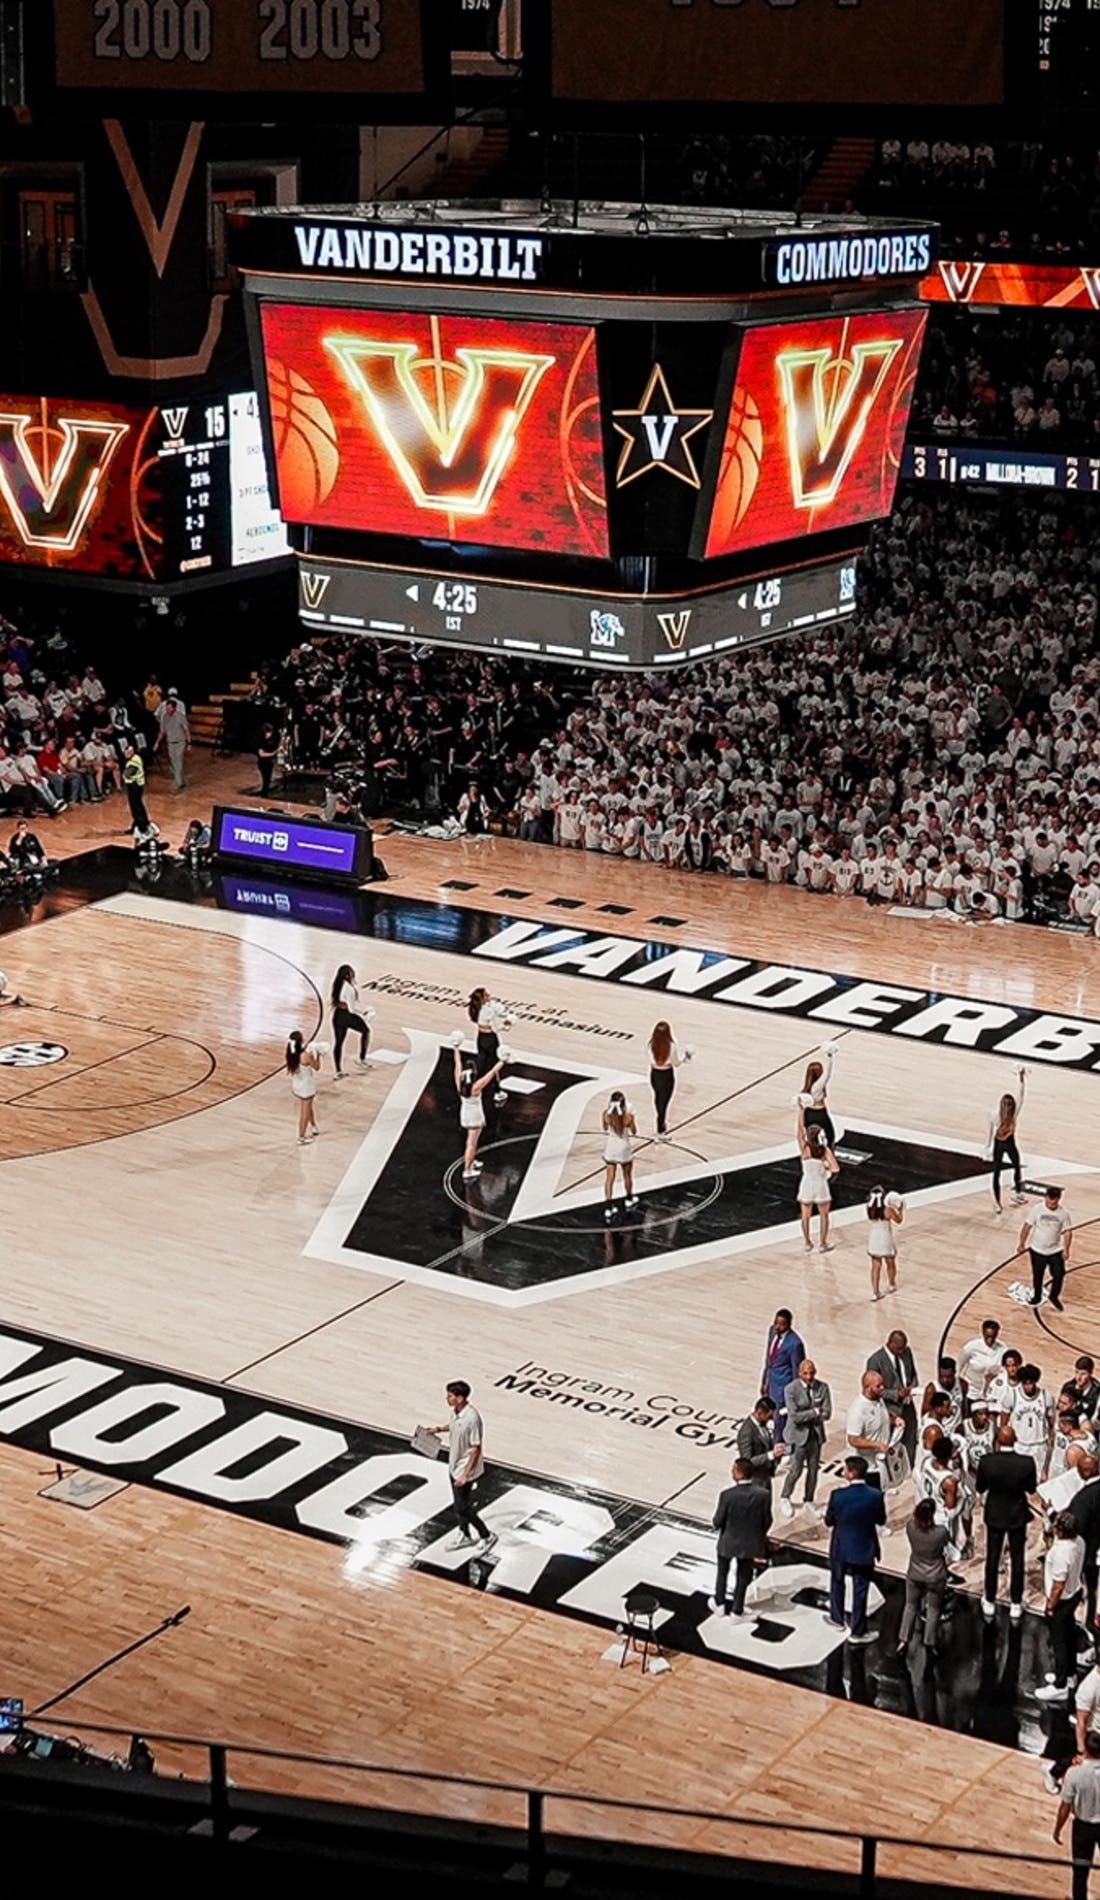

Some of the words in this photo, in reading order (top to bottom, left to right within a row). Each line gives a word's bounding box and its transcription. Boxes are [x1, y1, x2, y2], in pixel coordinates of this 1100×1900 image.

[93, 0, 212, 60] 2000
[258, 0, 383, 60] 2003
[294, 226, 543, 280] VANDERBILT
[776, 234, 931, 284] COMMODORES
[161, 407, 189, 438] V
[205, 405, 226, 438] 15
[322, 336, 556, 515] V
[641, 415, 679, 461] V
[775, 338, 904, 509] V
[914, 457, 926, 478] 3
[938, 458, 947, 480] 1
[1066, 468, 1079, 489] 2
[1091, 470, 1099, 491] 1
[185, 513, 205, 531] 2-3
[300, 571, 331, 608] V
[432, 581, 478, 614] 4:25
[656, 610, 692, 649] V
[753, 579, 782, 611] 4:25
[233, 828, 273, 846] TRUIST
[378, 973, 461, 997] Ingram
[471, 921, 1100, 1068] VANDERB
[493, 1374, 670, 1429] Memorial
[515, 1360, 635, 1402] Ingram
